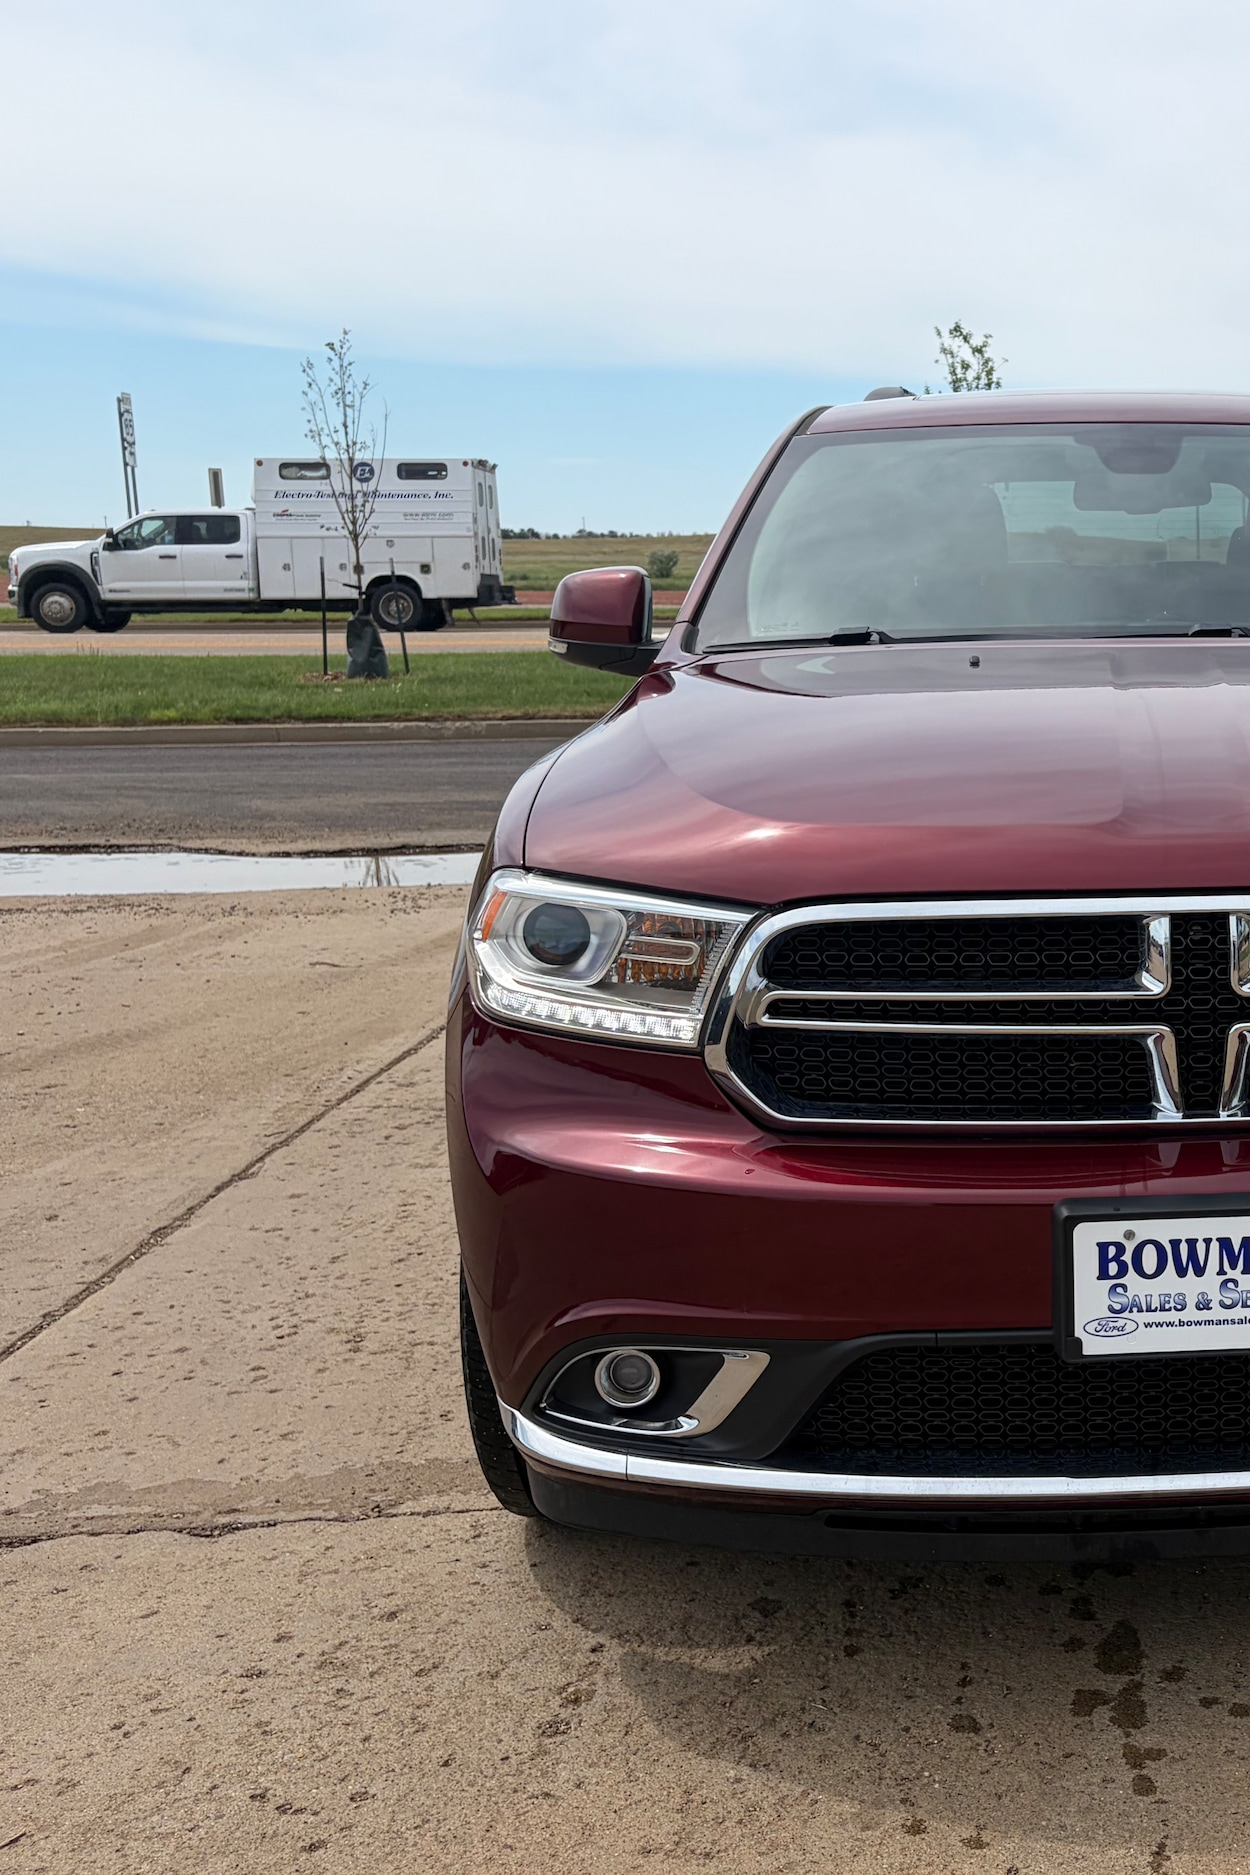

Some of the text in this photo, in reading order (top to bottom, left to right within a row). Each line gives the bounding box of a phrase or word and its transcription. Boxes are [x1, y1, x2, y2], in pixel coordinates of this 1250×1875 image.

[434, 491, 454, 499] Inc.
[1195, 1292, 1213, 1311] &
[1094, 1320, 1127, 1334] Ford
